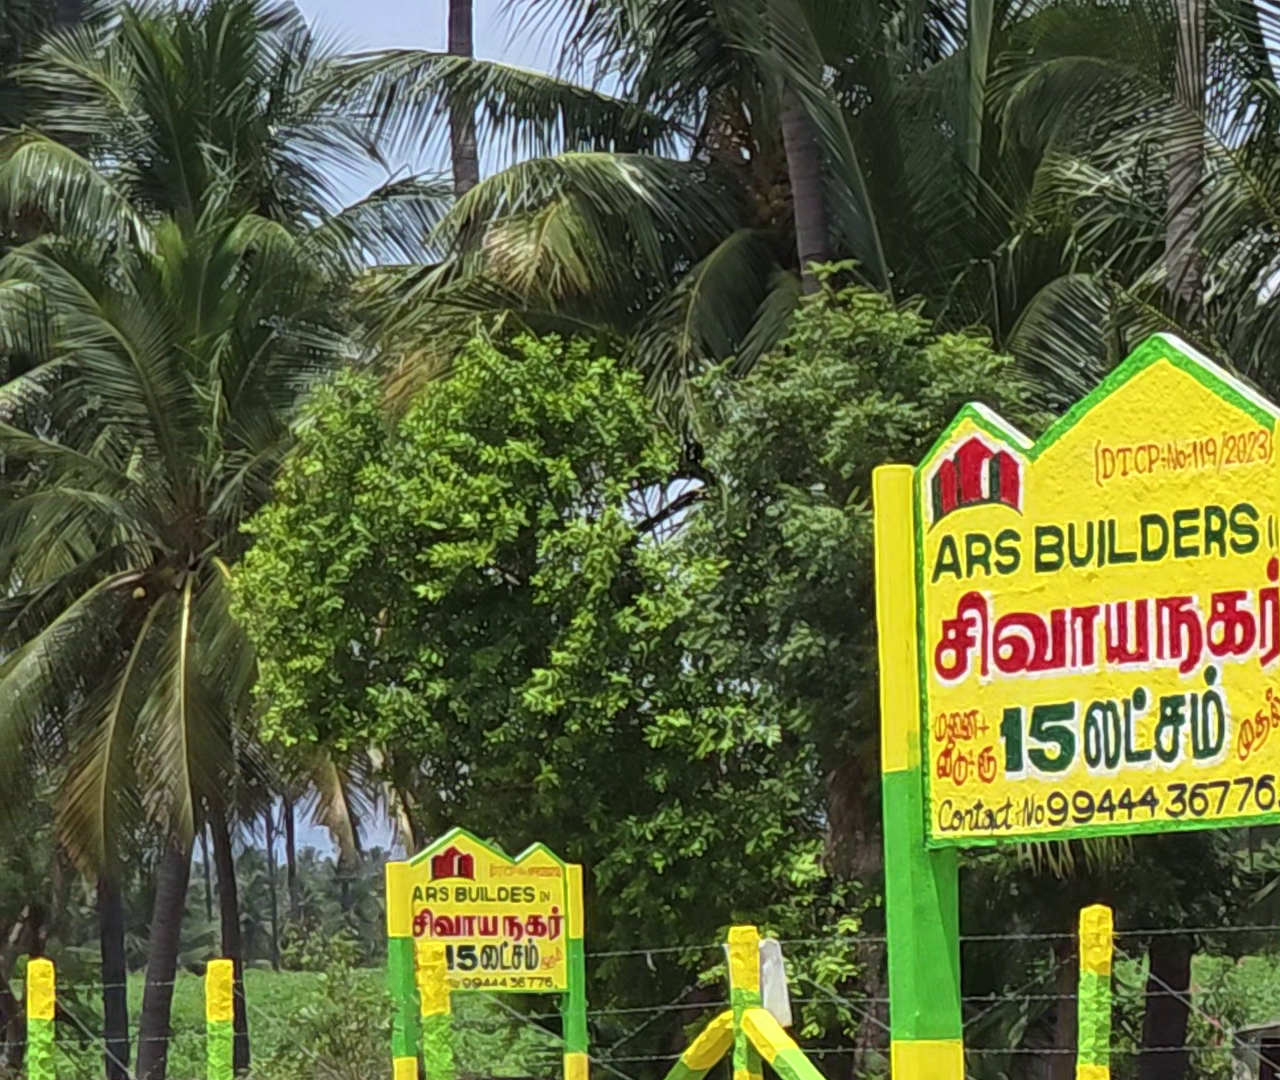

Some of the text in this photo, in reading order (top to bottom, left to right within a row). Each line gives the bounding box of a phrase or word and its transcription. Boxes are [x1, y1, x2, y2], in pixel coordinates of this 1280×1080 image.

[931, 529, 1022, 584] ARS
[1034, 503, 1260, 574] BUILDERS
[1046, 786, 1160, 826] 99444
[413, 885, 449, 902] ARS
[455, 886, 536, 903] BUILDES
